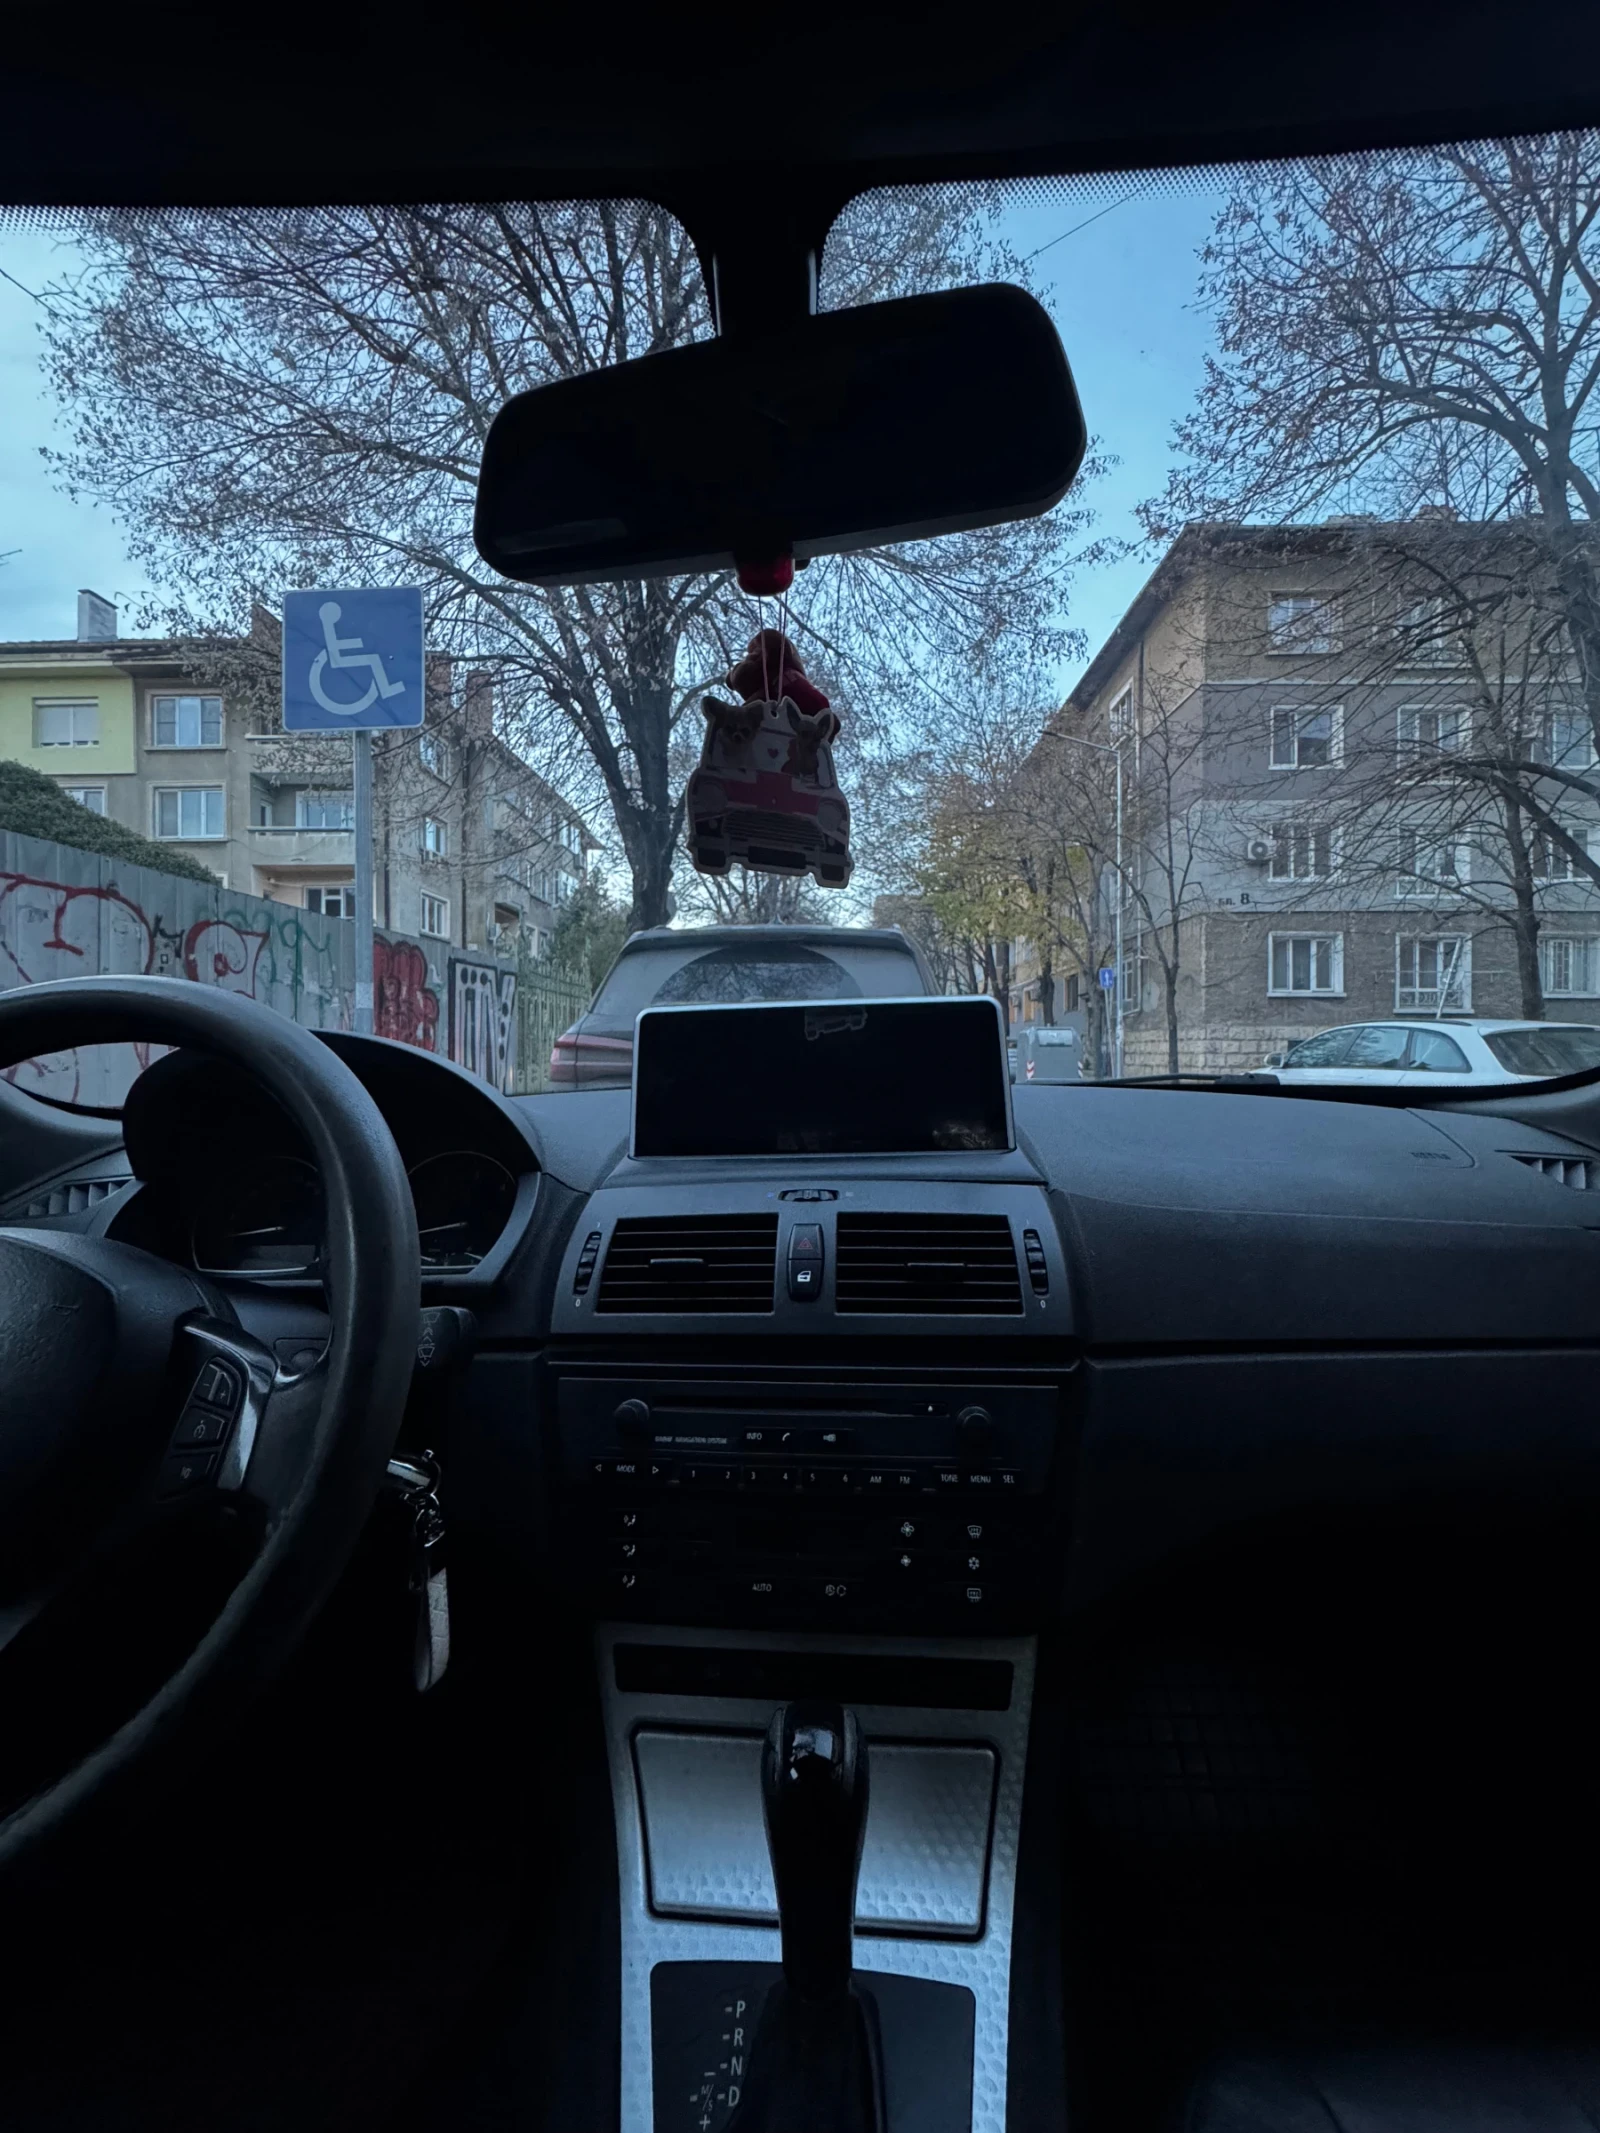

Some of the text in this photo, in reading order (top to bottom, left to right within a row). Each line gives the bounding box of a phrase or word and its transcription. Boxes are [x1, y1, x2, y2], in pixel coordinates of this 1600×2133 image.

[746, 1432, 763, 1441] INFO
[616, 1464, 636, 1474] MODE
[691, 1469, 696, 1479] 1
[725, 1470, 731, 1480] 2
[751, 1470, 757, 1480] 3
[782, 1471, 788, 1481] 4
[810, 1472, 816, 1482] 5
[842, 1473, 848, 1483] 6
[869, 1475, 882, 1484] AM
[899, 1475, 911, 1485] FM
[940, 1473, 959, 1483] TONE
[970, 1474, 992, 1484] MENU
[1002, 1474, 1015, 1484] SEL
[751, 1582, 773, 1593] AUTO
[735, 1999, 747, 2019] P
[733, 2027, 744, 2047] R
[730, 2055, 743, 2076] N
[727, 2085, 740, 2107] D
